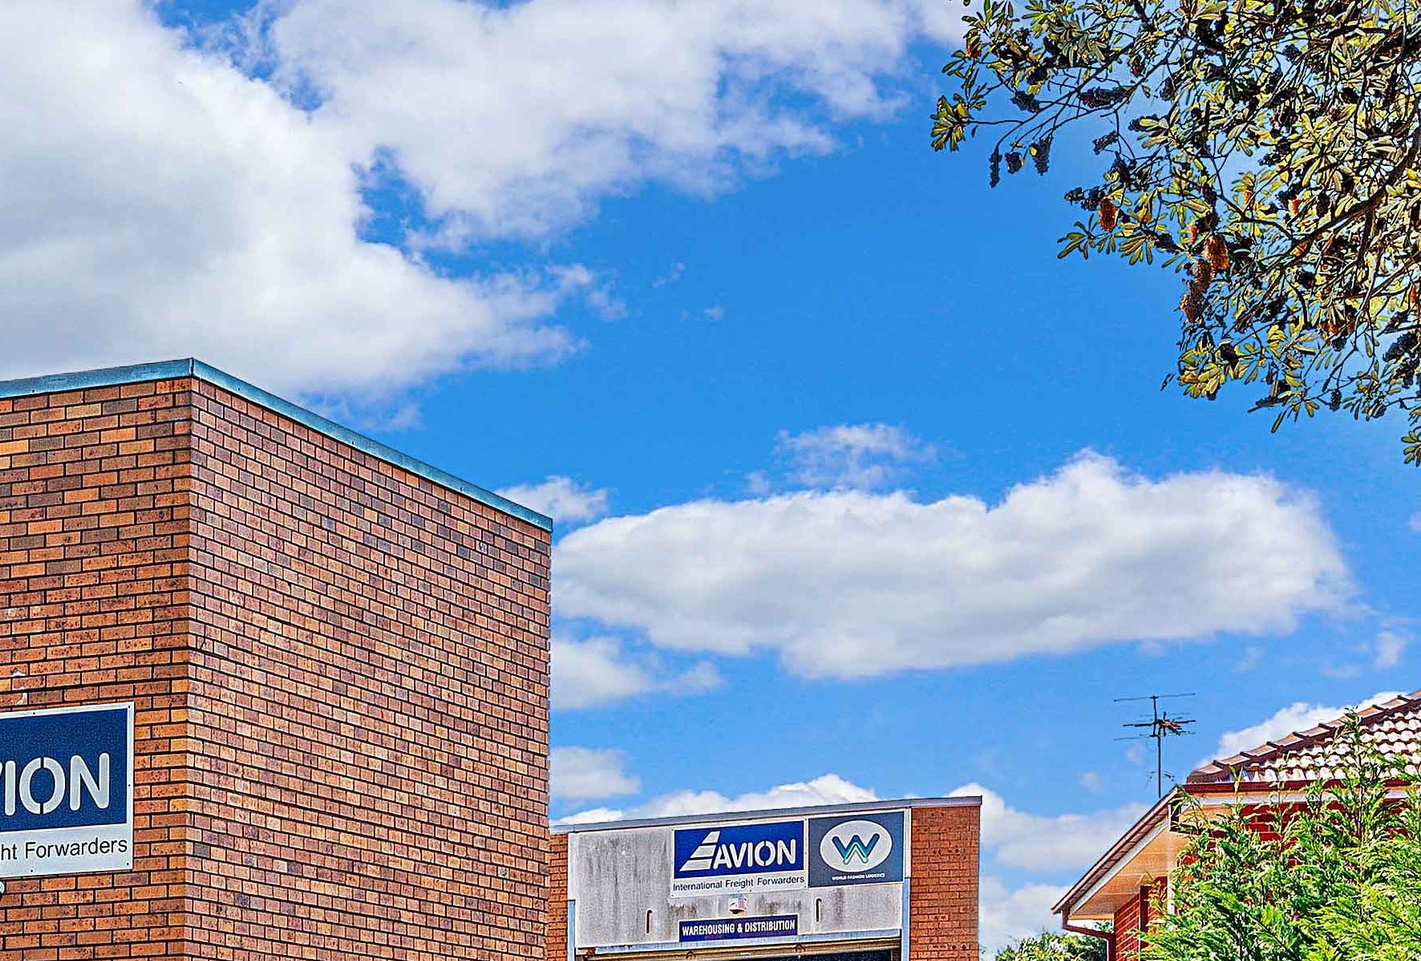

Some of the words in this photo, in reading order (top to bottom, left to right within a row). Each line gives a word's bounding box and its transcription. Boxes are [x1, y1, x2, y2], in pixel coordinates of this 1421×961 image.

[25, 836, 128, 861] Forwarders
[713, 839, 796, 870] AVION
[672, 880, 723, 892] International
[725, 879, 754, 890] Freight
[757, 875, 805, 886] Forwarders
[682, 923, 736, 937] WAREHOUSING
[736, 923, 743, 933] &
[744, 919, 796, 933] DISTRIBUTION
